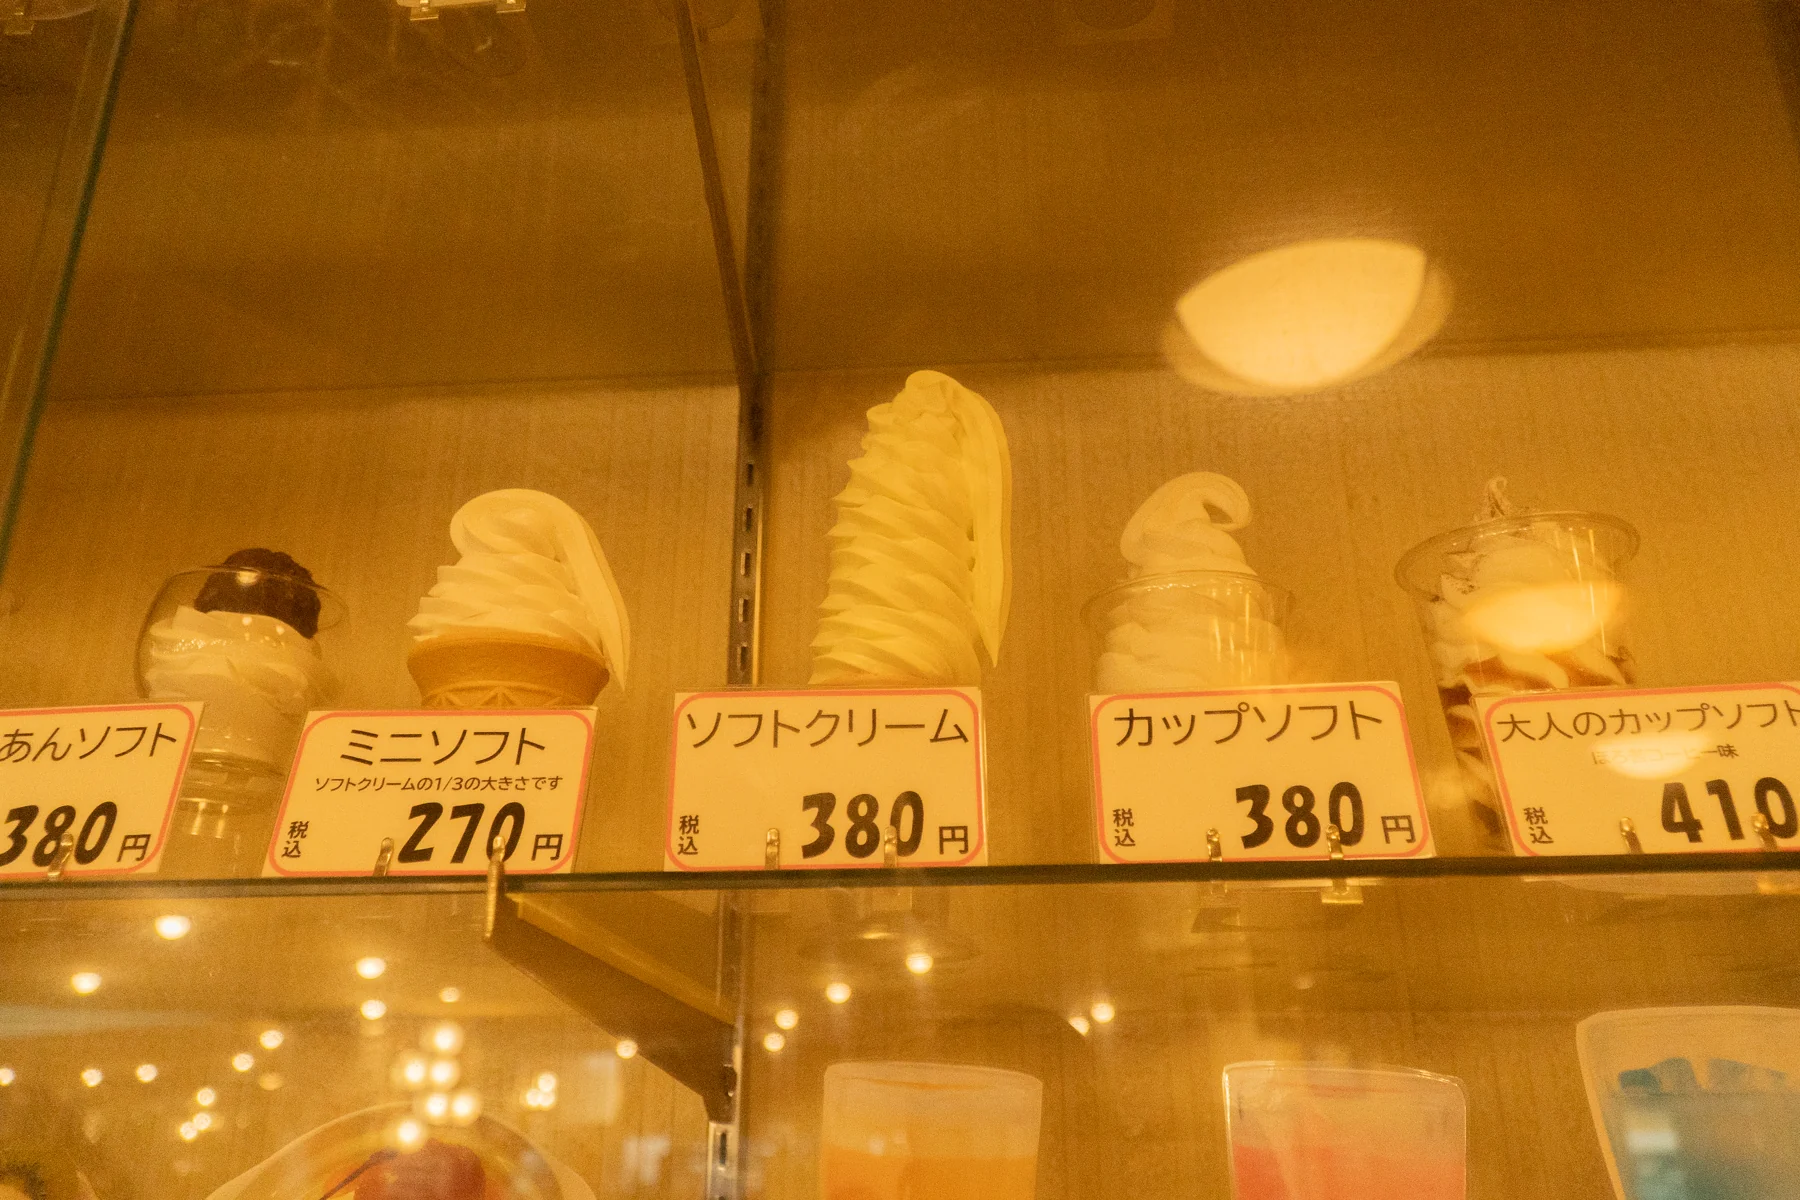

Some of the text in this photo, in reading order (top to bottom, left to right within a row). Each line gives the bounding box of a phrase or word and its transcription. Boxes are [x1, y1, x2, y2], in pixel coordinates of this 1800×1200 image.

[687, 708, 969, 748] ソフトクリーム
[1113, 700, 1383, 746] カップソフト
[1496, 699, 1800, 743] 大人のカップソフト
[0, 722, 177, 763] あんソフト
[340, 727, 546, 766] ミニソフト
[315, 775, 563, 792] ソフトクリームの1/3の大きさです
[1112, 808, 1136, 848] 税込
[1523, 806, 1555, 844] 税込
[1660, 776, 1799, 843] 410
[281, 820, 310, 858] 税込
[677, 814, 700, 856] 税込
